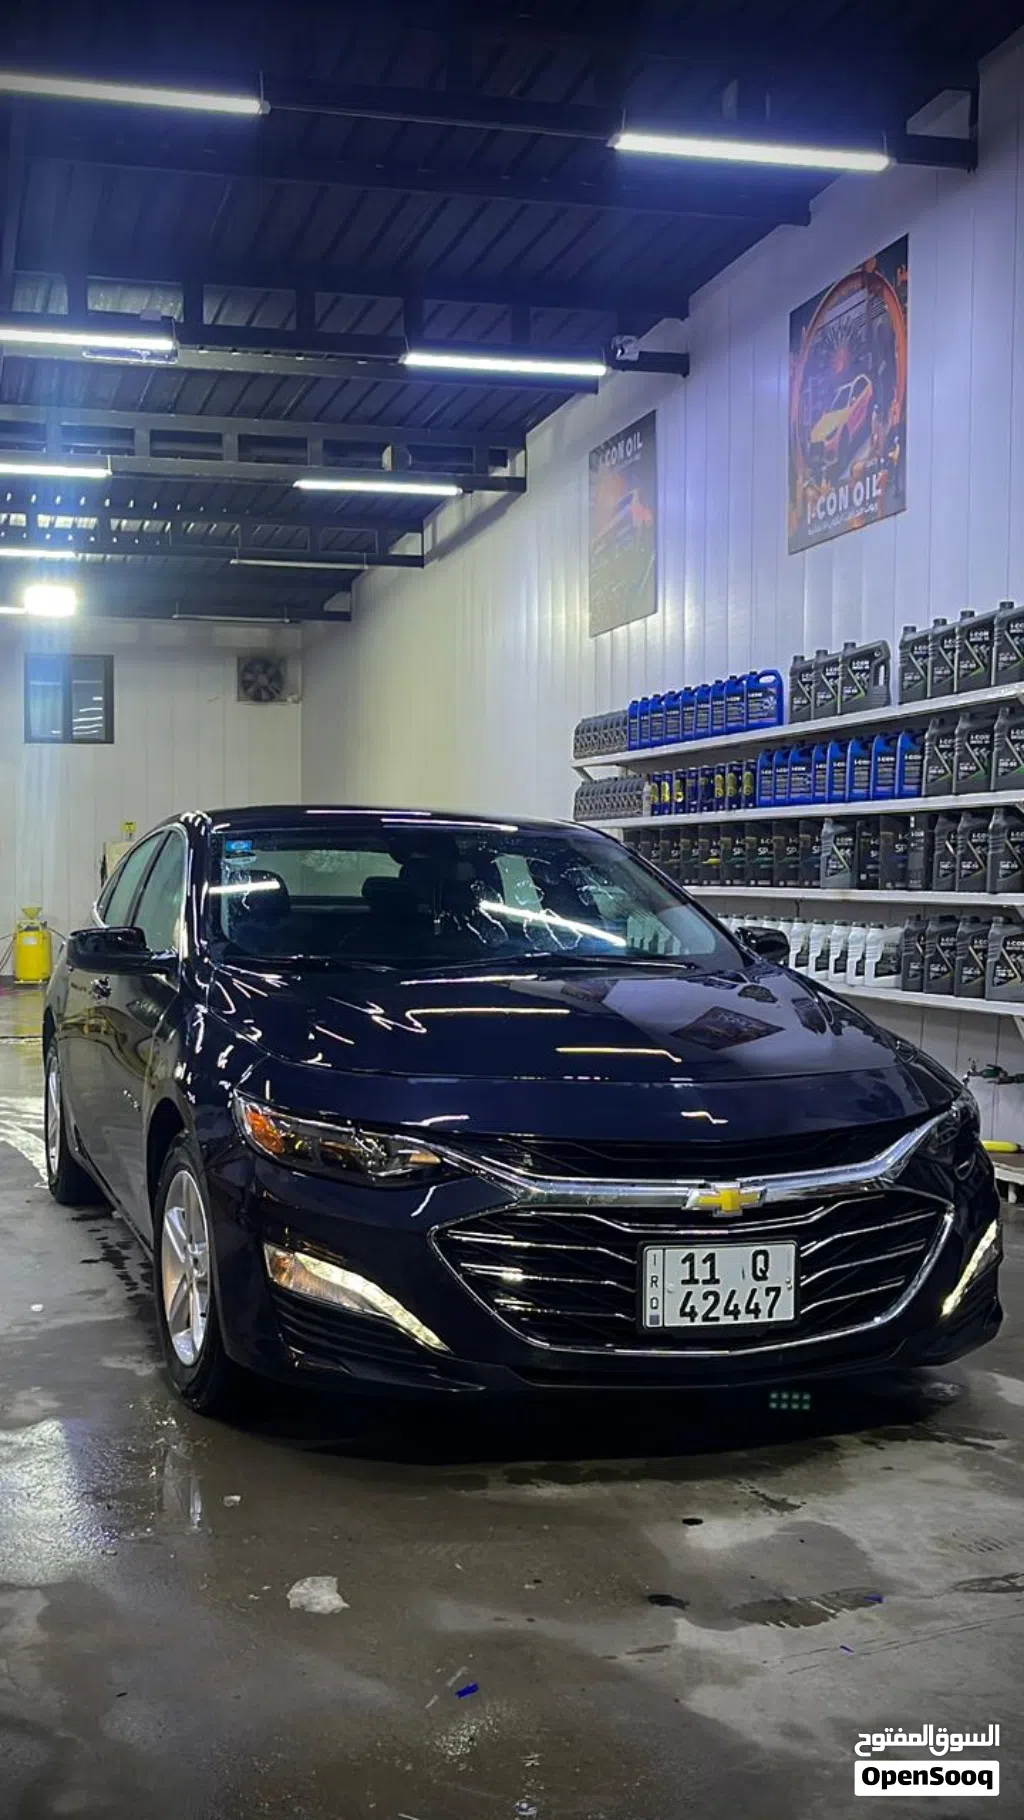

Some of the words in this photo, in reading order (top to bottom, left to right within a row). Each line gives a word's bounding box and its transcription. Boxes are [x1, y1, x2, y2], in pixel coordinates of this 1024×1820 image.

[626, 432, 643, 457] OIL
[807, 485, 849, 525] I-CON
[853, 473, 883, 507] OIL
[680, 1252, 720, 1285] 11
[751, 1249, 769, 1281] Q
[679, 1286, 782, 1323] 42447
